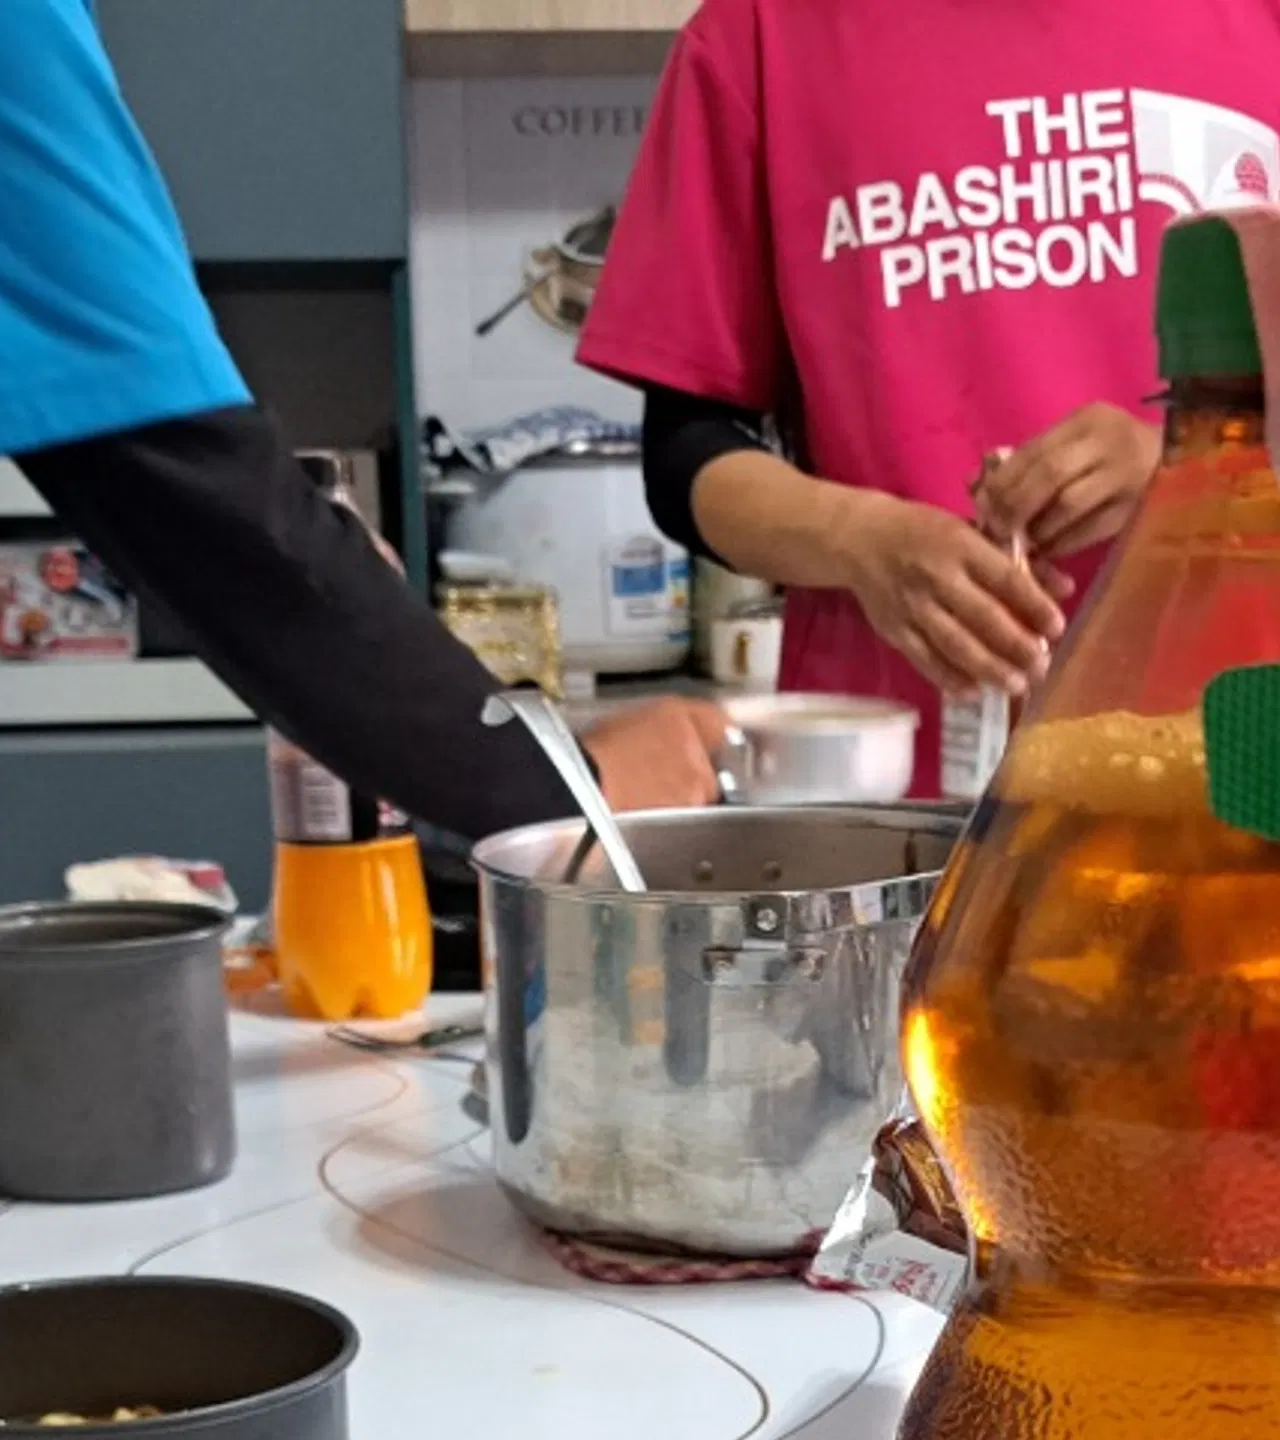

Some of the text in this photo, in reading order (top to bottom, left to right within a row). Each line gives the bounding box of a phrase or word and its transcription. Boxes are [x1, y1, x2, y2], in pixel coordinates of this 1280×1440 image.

[985, 89, 1128, 158] THE
[822, 151, 1133, 261] ABASHIRI
[880, 218, 1138, 308] PRISON
